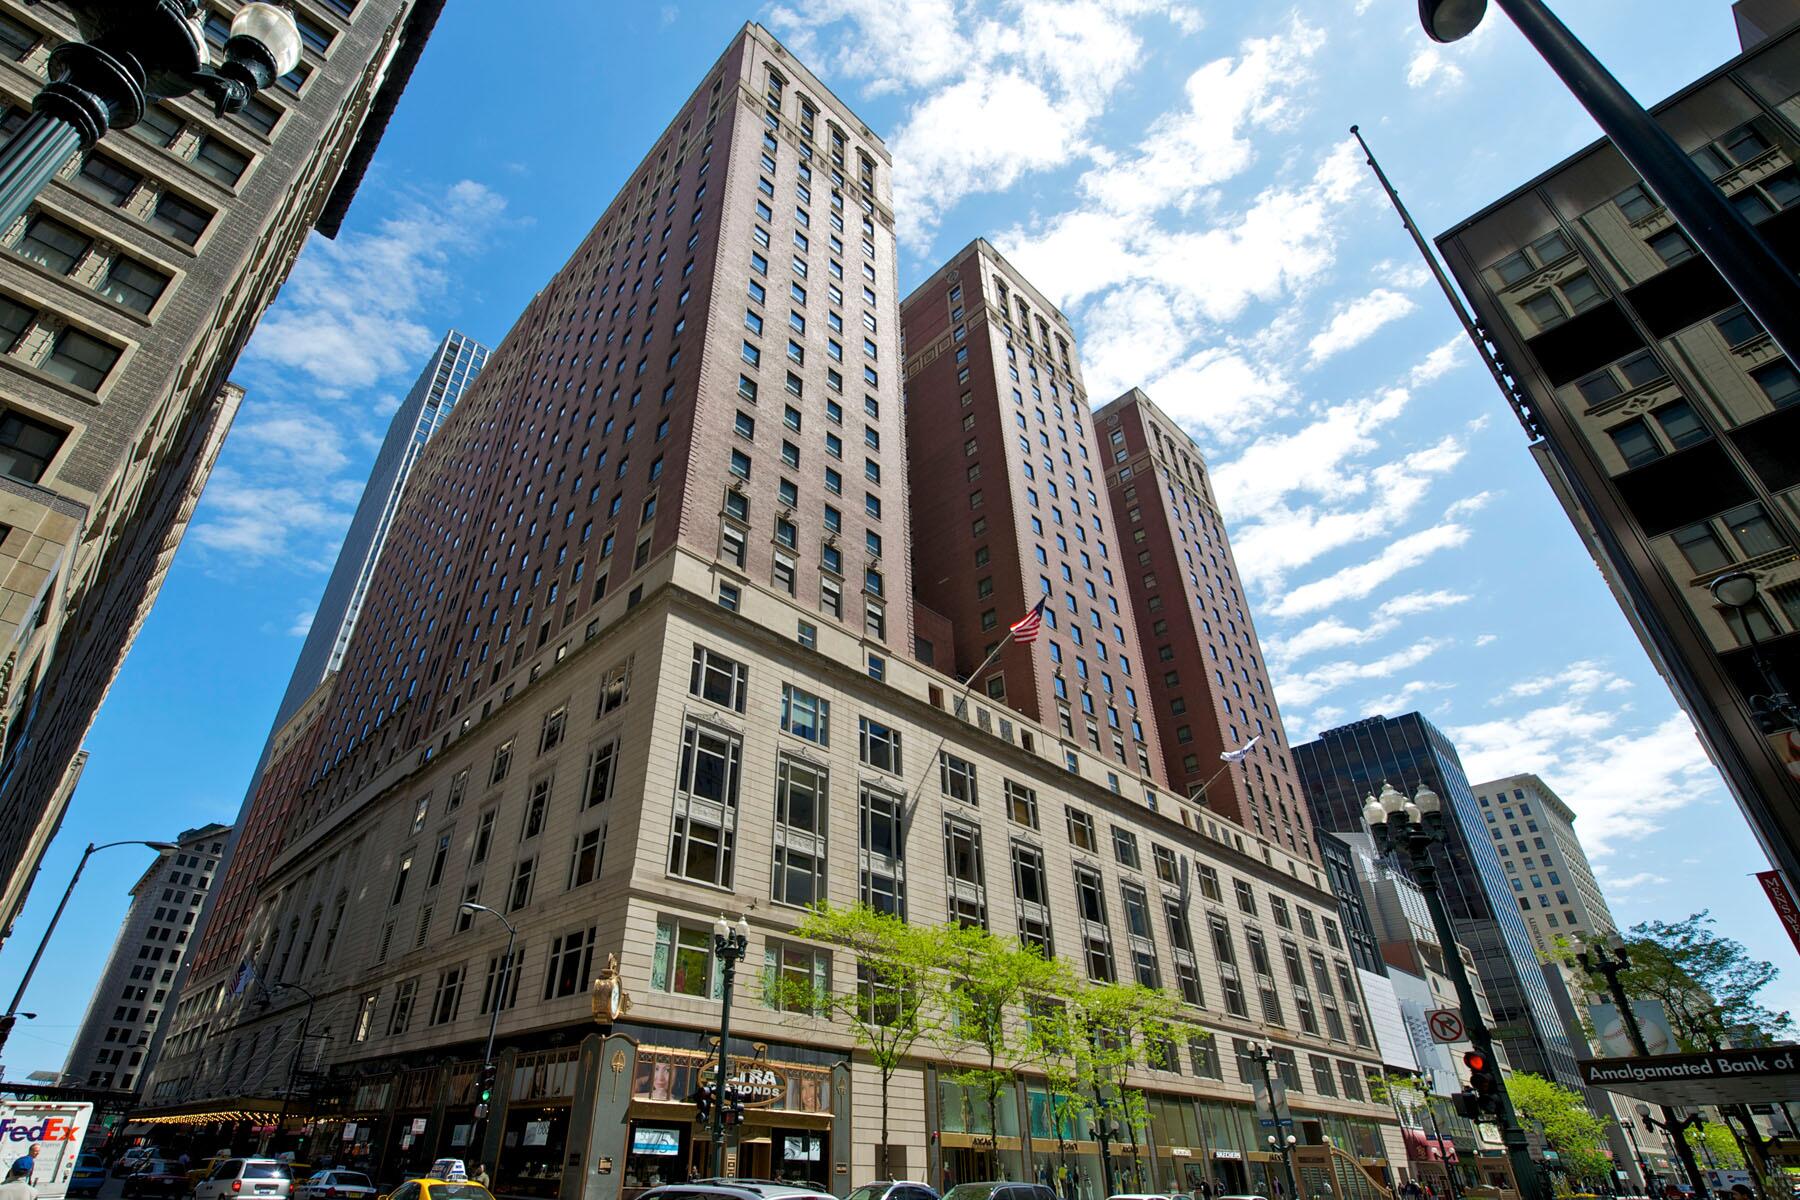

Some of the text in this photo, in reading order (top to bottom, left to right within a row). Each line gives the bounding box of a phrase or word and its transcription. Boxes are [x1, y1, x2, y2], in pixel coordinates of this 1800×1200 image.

[1765, 877, 1800, 940] MENSWE
[1590, 1053, 1795, 1081] Amalgamated Bank of
[0, 1118, 80, 1141] FedEx
